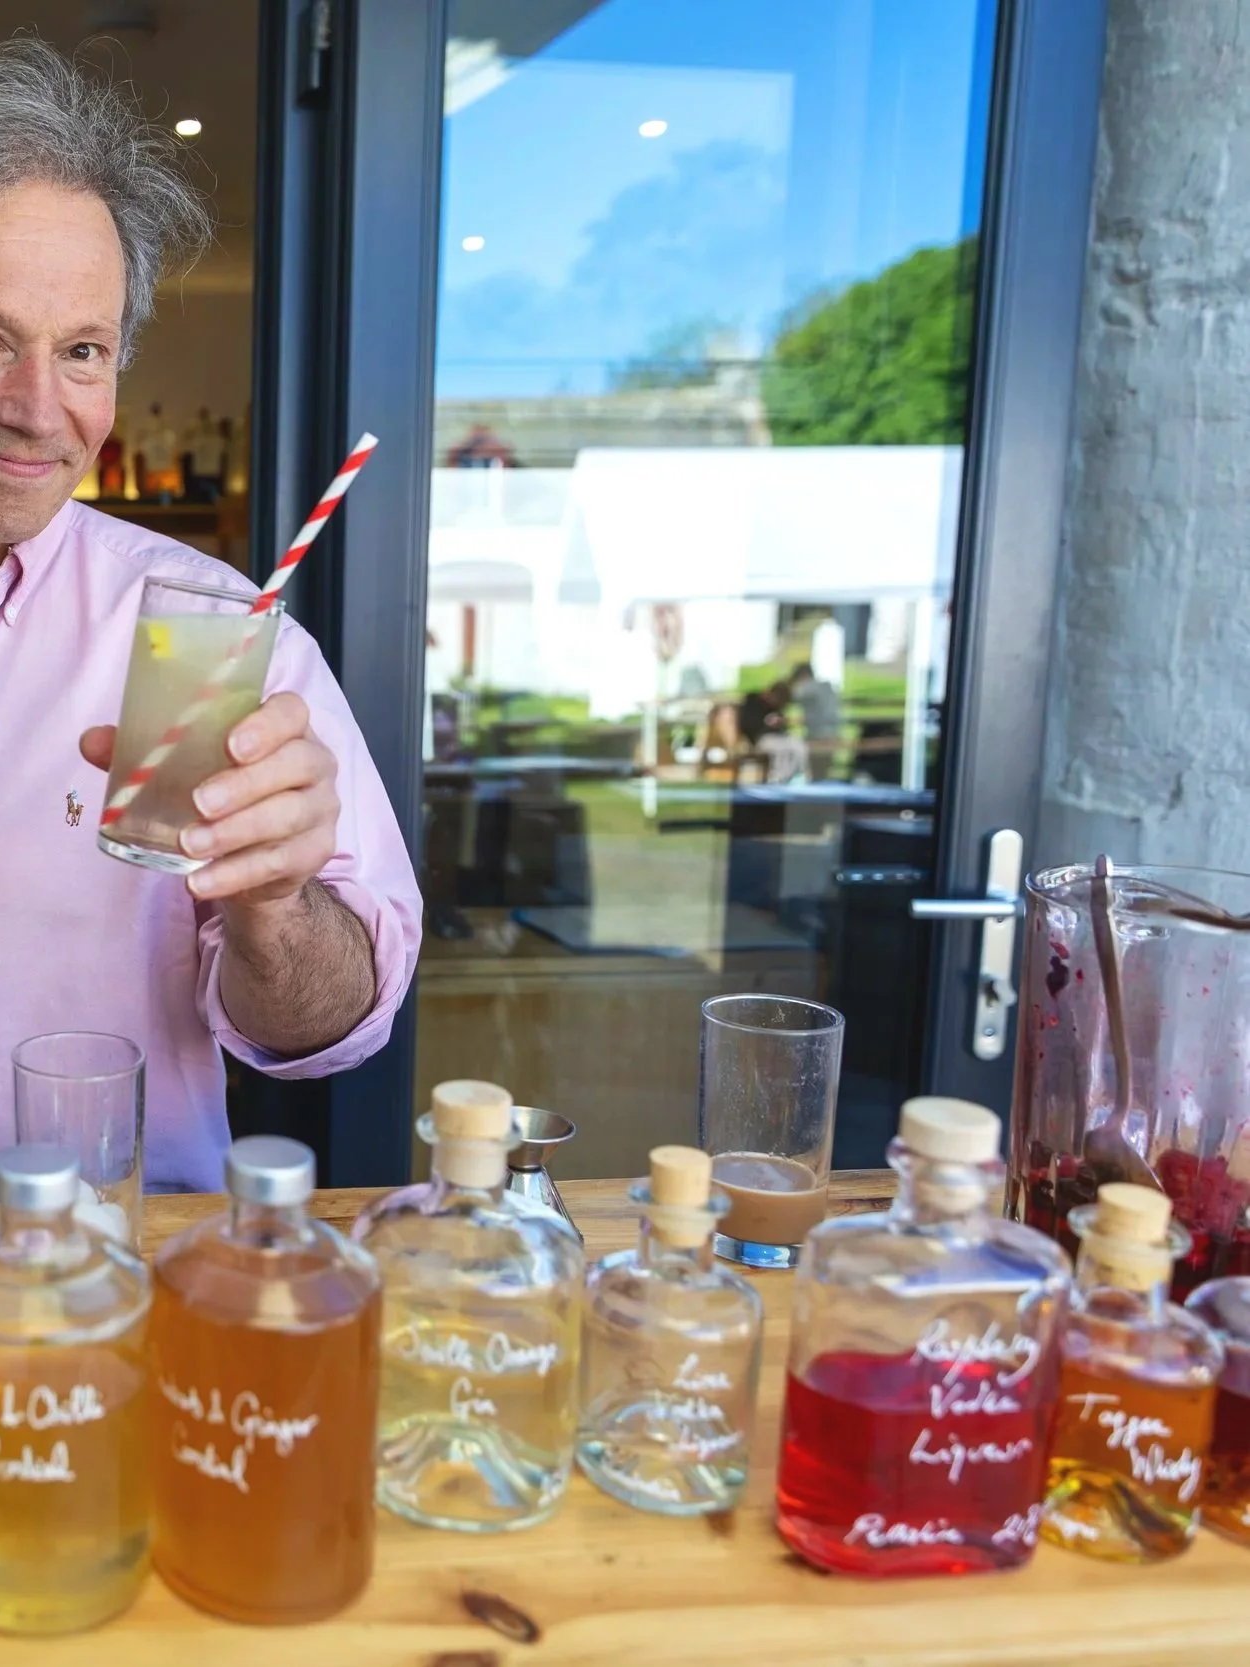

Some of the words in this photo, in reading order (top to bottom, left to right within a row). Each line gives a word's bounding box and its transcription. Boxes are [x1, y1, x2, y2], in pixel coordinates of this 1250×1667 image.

[230, 1388, 321, 1459] Ginger
[450, 1376, 497, 1423] Gin
[930, 1379, 1022, 1420] Vodka
[909, 1427, 1033, 1485] Liqueur
